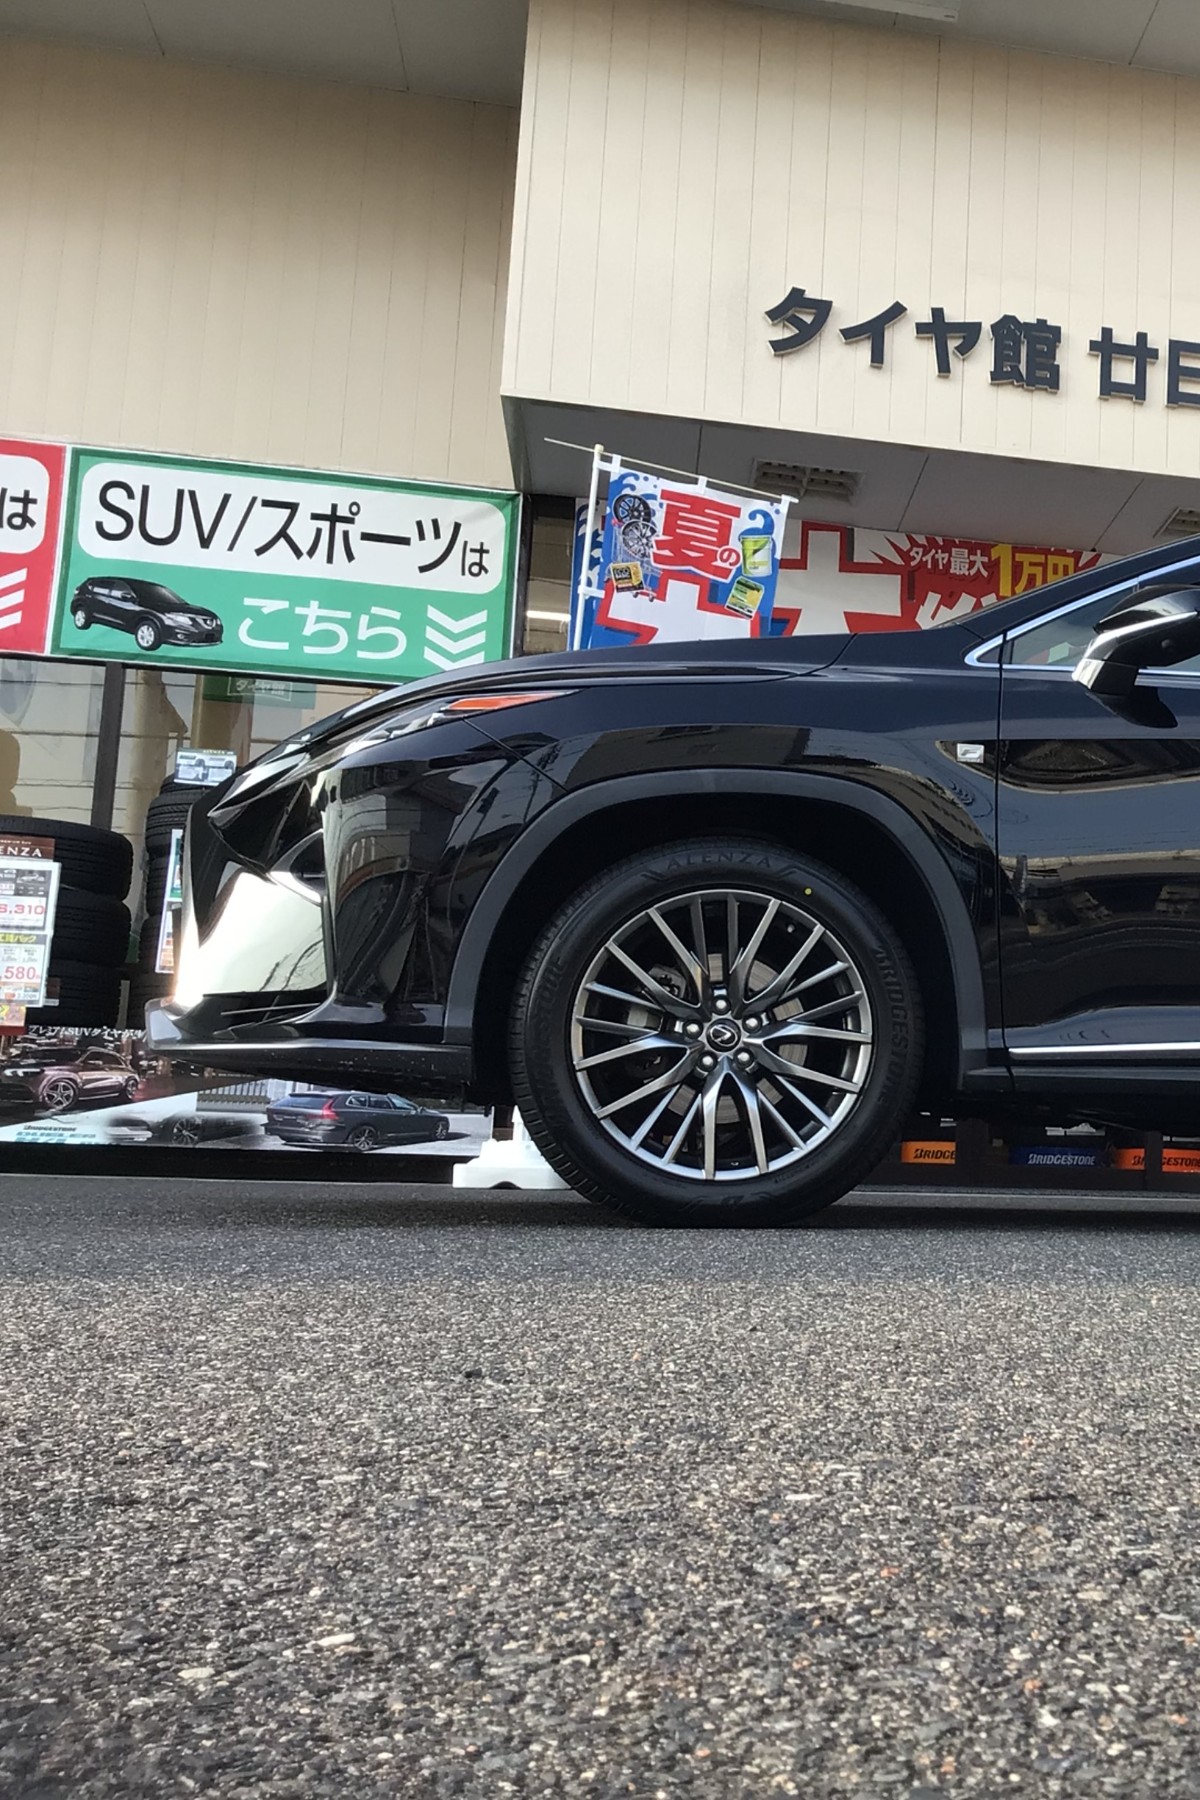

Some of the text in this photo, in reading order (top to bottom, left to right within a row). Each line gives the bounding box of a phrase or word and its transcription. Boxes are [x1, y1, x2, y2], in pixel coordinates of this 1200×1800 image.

[764, 286, 1062, 392] タイヤ館
[237, 597, 408, 660] こちら
[1027, 1153, 1096, 1166] BRIDGESTONE
